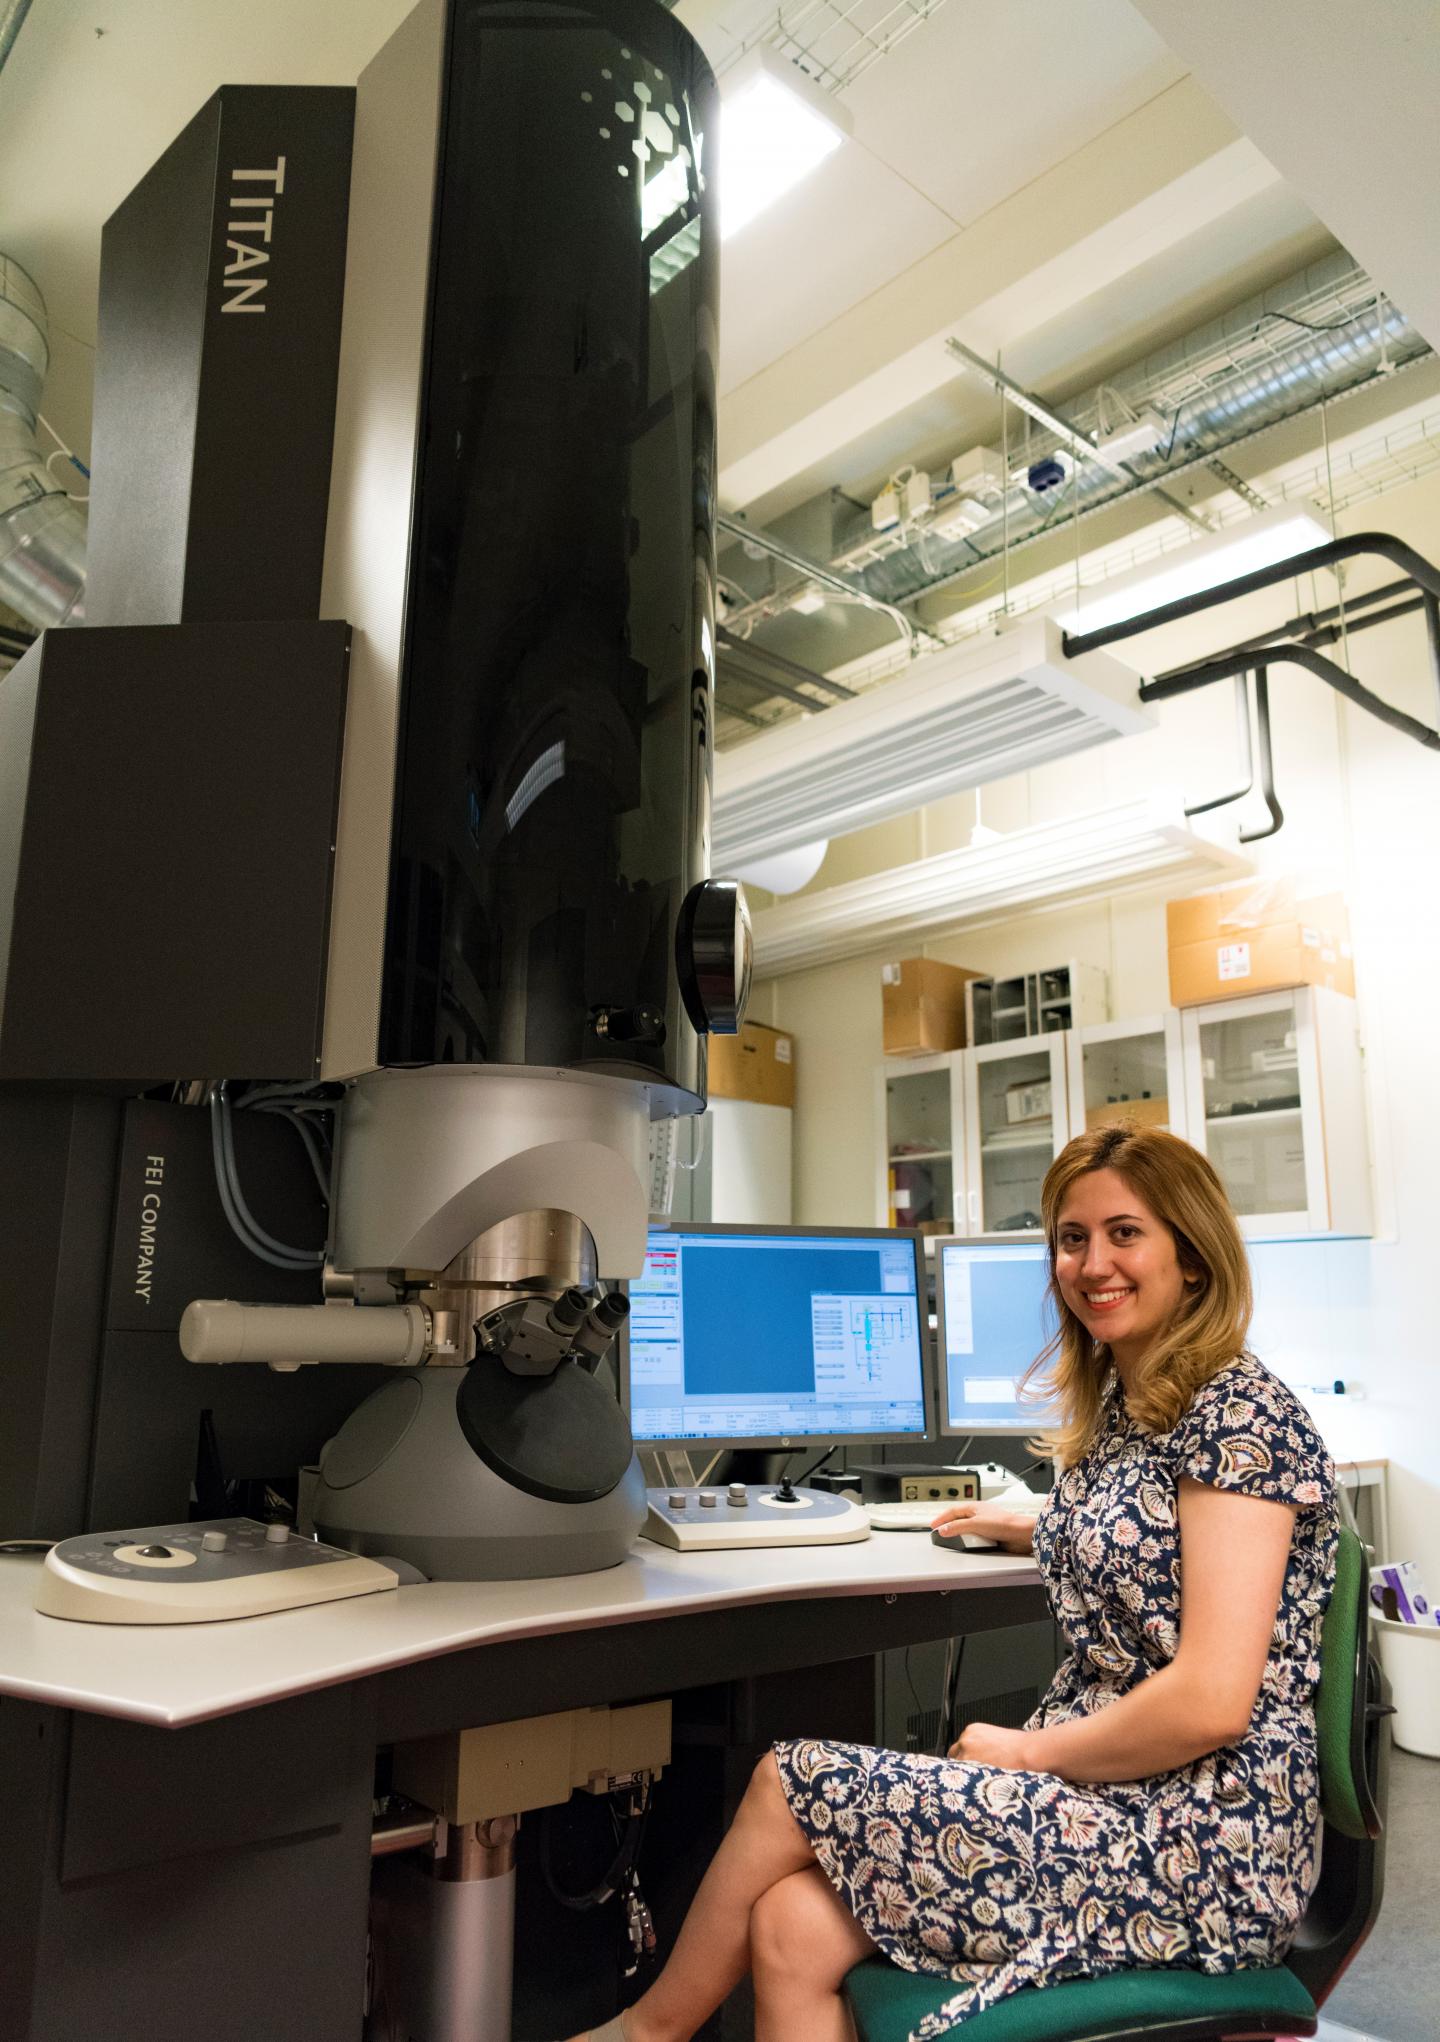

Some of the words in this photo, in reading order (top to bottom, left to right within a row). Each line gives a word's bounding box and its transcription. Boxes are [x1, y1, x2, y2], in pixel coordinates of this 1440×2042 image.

[220, 155, 286, 313] TITAN
[144, 1155, 164, 1186] FEI
[135, 1193, 161, 1300] COMPANY
